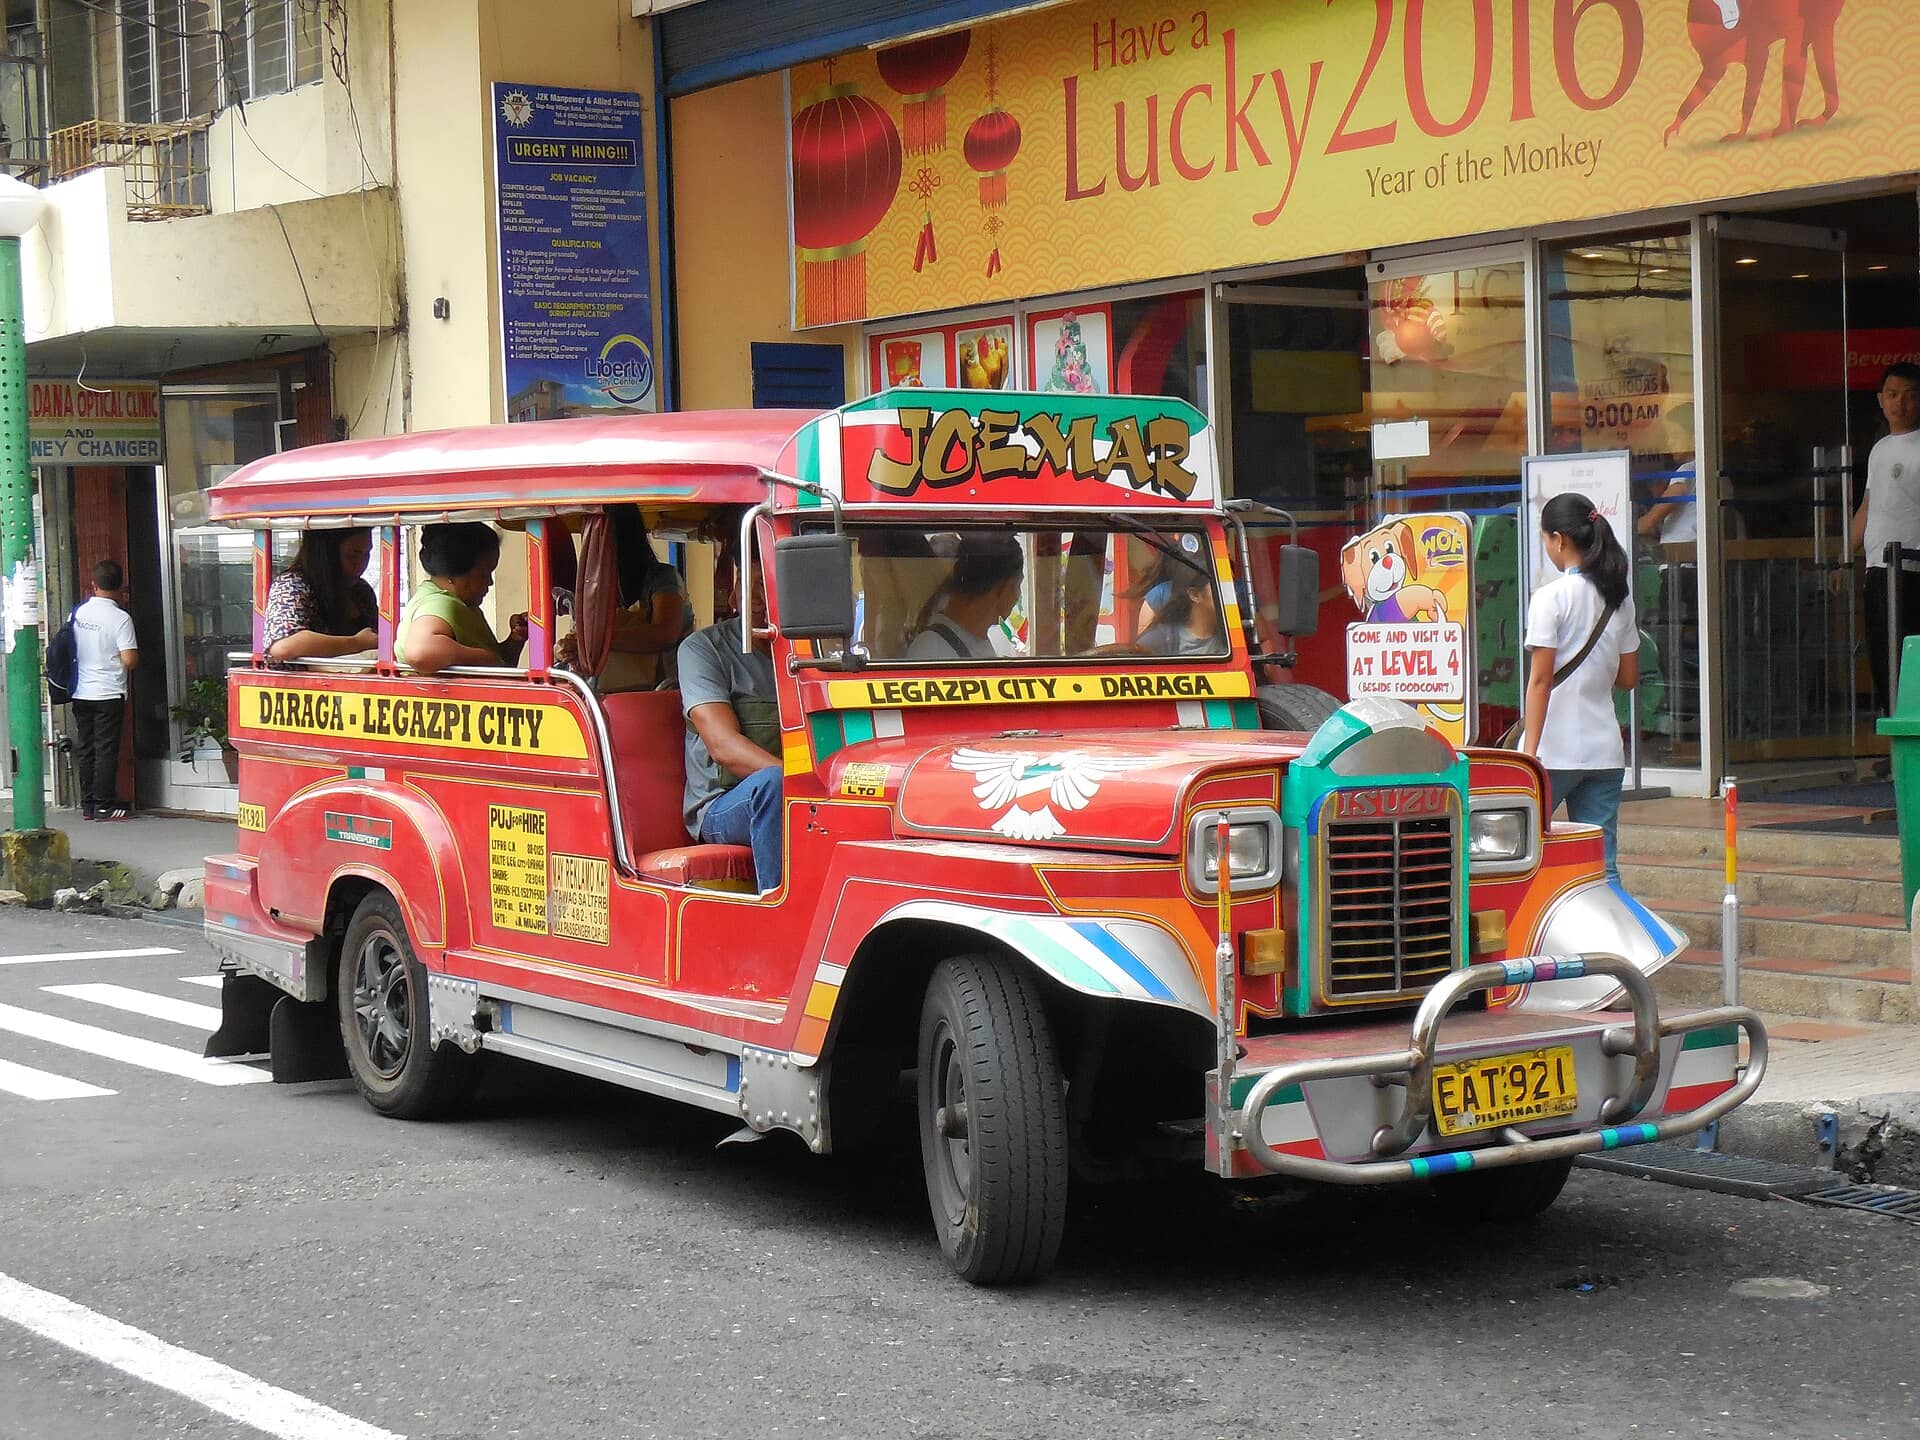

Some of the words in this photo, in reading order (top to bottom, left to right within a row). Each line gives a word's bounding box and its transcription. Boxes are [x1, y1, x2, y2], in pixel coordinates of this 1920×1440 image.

[1093, 18, 1176, 71] Have
[1191, 10, 1209, 50] a
[550, 94, 585, 104] Manpower
[593, 97, 611, 106] Allied
[612, 98, 640, 108] Services
[1063, 28, 1324, 226] Lucky
[1324, 0, 1644, 155] 2016
[514, 143, 566, 158] URGENT
[571, 145, 628, 160] HIRING!!!
[1366, 166, 1416, 198] Year
[1424, 152, 1449, 188] of
[1455, 150, 1493, 185] the
[1503, 133, 1602, 178] Monkey
[550, 174, 562, 182] JOB
[564, 175, 597, 183] VACANCY
[552, 240, 601, 249] QUALIFICATION
[585, 357, 648, 382] Liberty
[598, 378, 611, 386] City
[29, 384, 74, 417] DANA
[78, 390, 123, 417] OPTICAL
[1584, 402, 1633, 428] 9:00
[1636, 404, 1660, 420] AM
[64, 429, 95, 438] AND
[32, 440, 68, 457] NEY
[77, 441, 158, 457] CHANGER
[866, 405, 1198, 502] JOEMAR
[1352, 631, 1381, 643] COME
[1386, 630, 1407, 642] AND
[1413, 630, 1439, 642] VISIT
[1444, 630, 1458, 642] US
[1353, 657, 1373, 676] AT
[1381, 649, 1437, 676] LEVEL
[1448, 649, 1459, 676] 4
[866, 679, 992, 705] LEGAZPI
[997, 677, 1057, 700] CITY
[1100, 674, 1215, 698] DARAGA
[1358, 683, 1391, 693] (BESIDE
[1395, 682, 1454, 693] FOODCOURT)
[259, 691, 344, 731] DARAGA
[363, 698, 471, 742] LEGAZPI
[478, 705, 544, 749] CITY
[848, 786, 876, 795] LTO
[1340, 787, 1443, 816] ISUZU
[491, 808, 512, 830] PUJ
[522, 812, 544, 835] HIRE
[566, 858, 594, 892] REKLAMO
[587, 892, 607, 909] LTFRB
[1475, 1105, 1542, 1123] PILIPINAS
